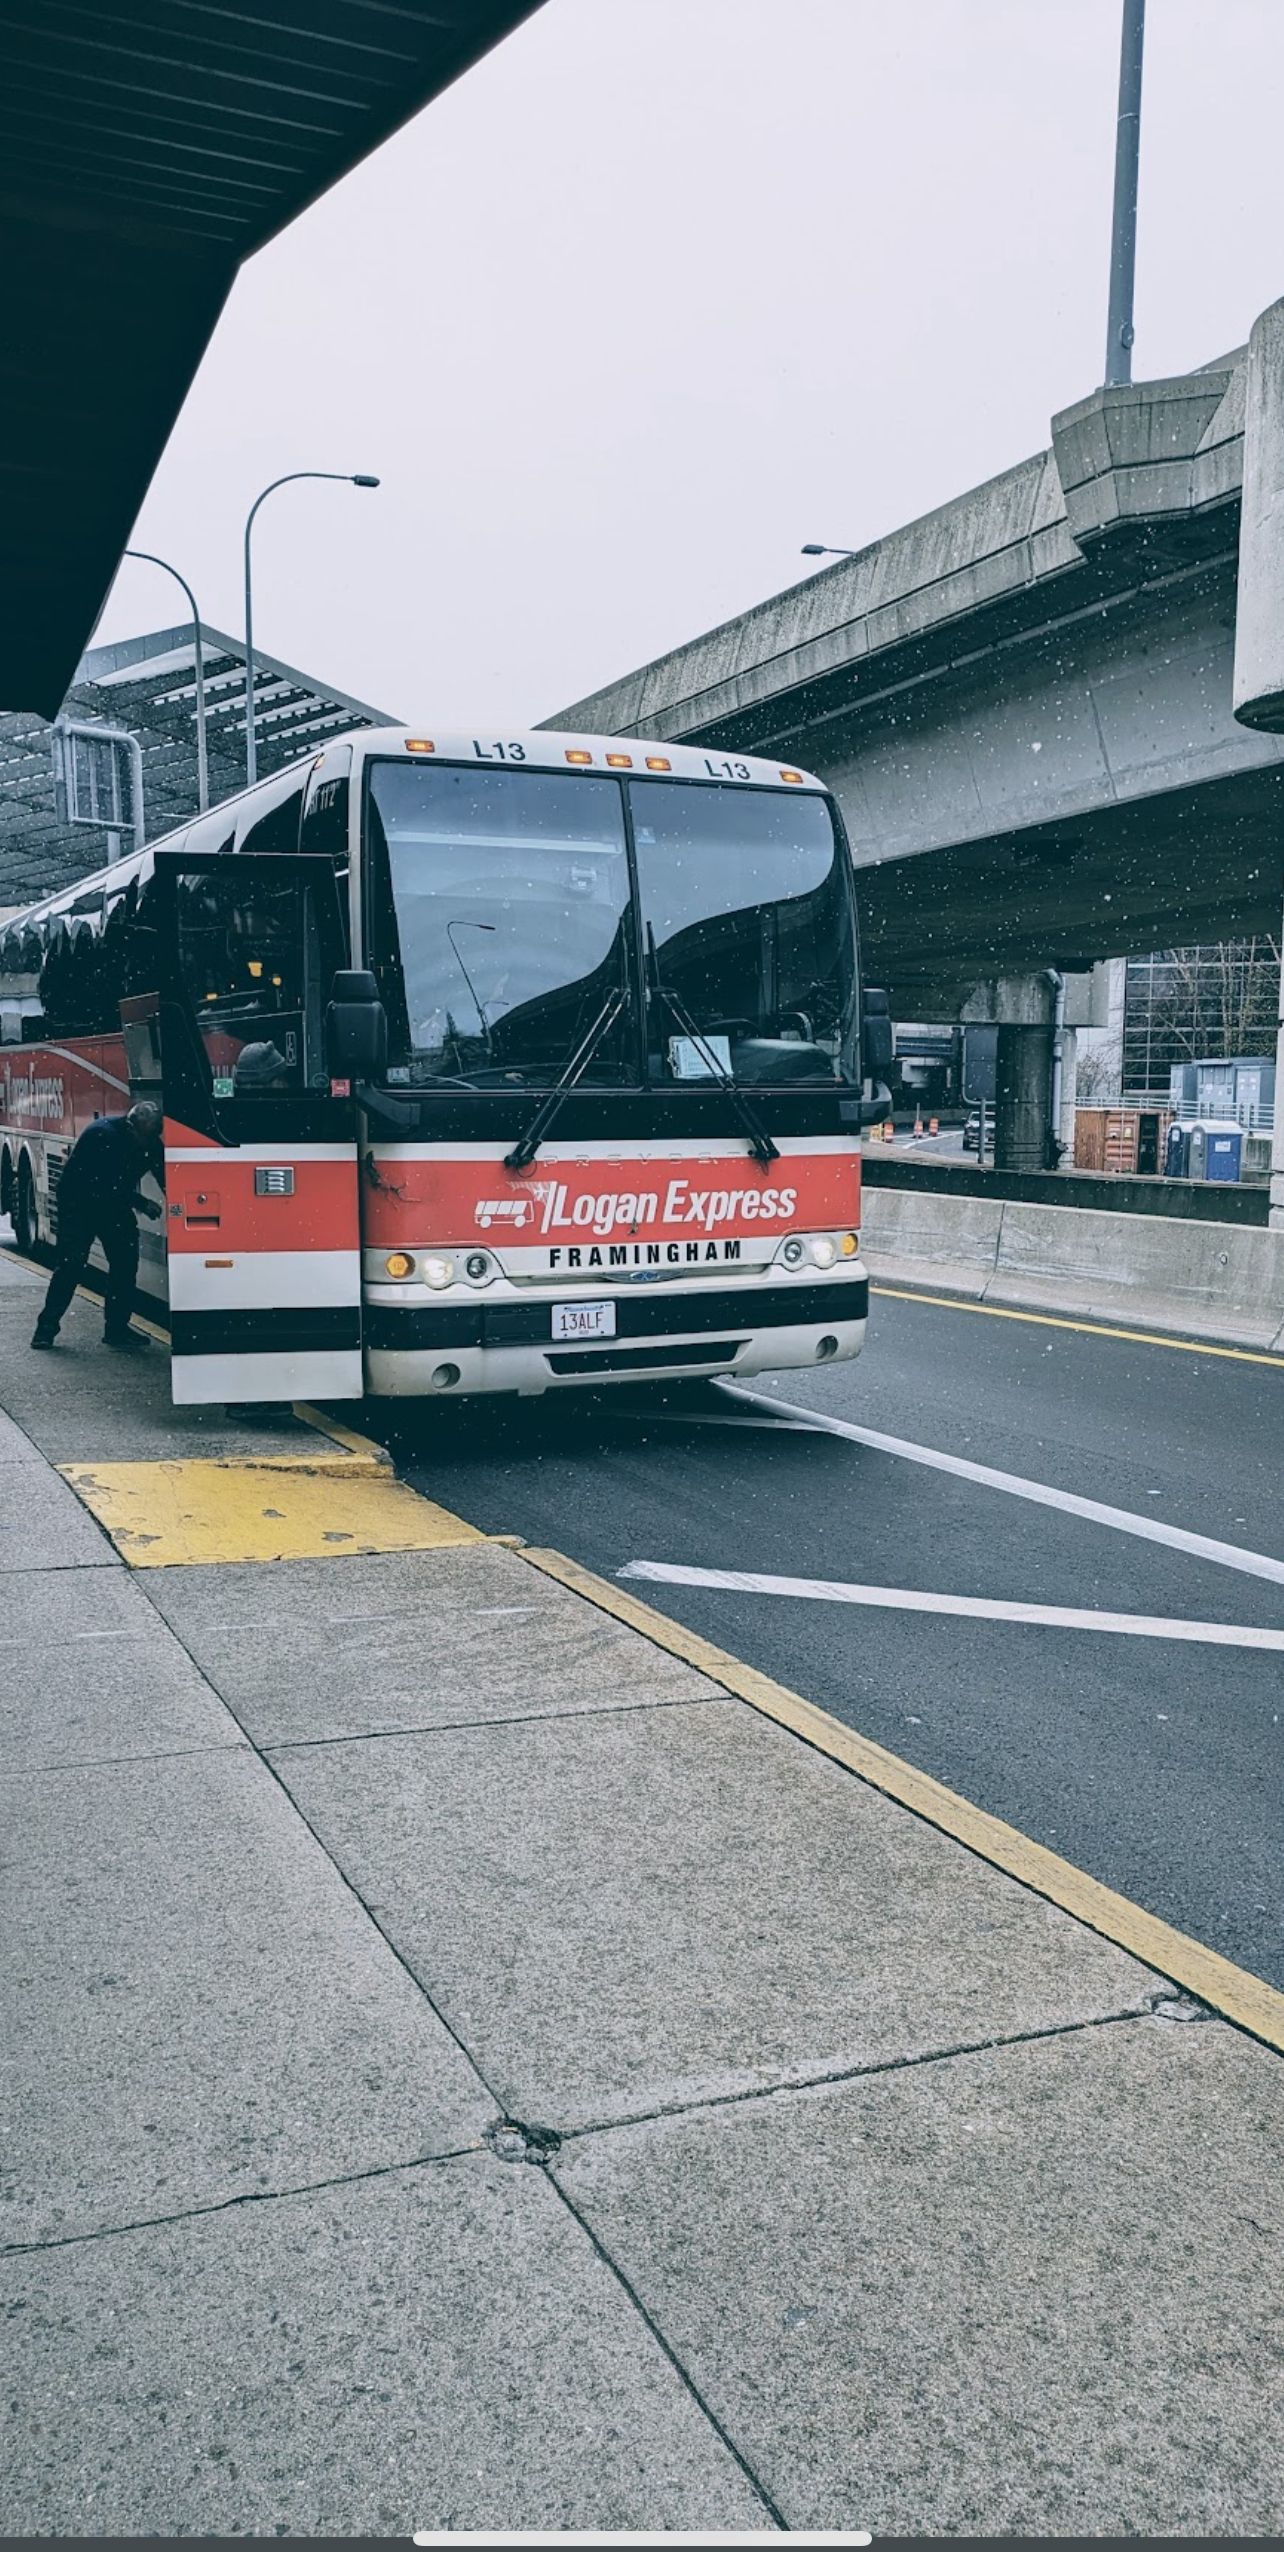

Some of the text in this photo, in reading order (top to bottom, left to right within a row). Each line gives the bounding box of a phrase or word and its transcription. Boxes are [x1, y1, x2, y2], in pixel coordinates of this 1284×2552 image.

[473, 740, 526, 761] L13
[704, 759, 751, 780] L13
[551, 1180, 797, 1235] Logan Express
[550, 1240, 741, 1268] FRAMINGHAM
[560, 1311, 604, 1331] 13ALF
